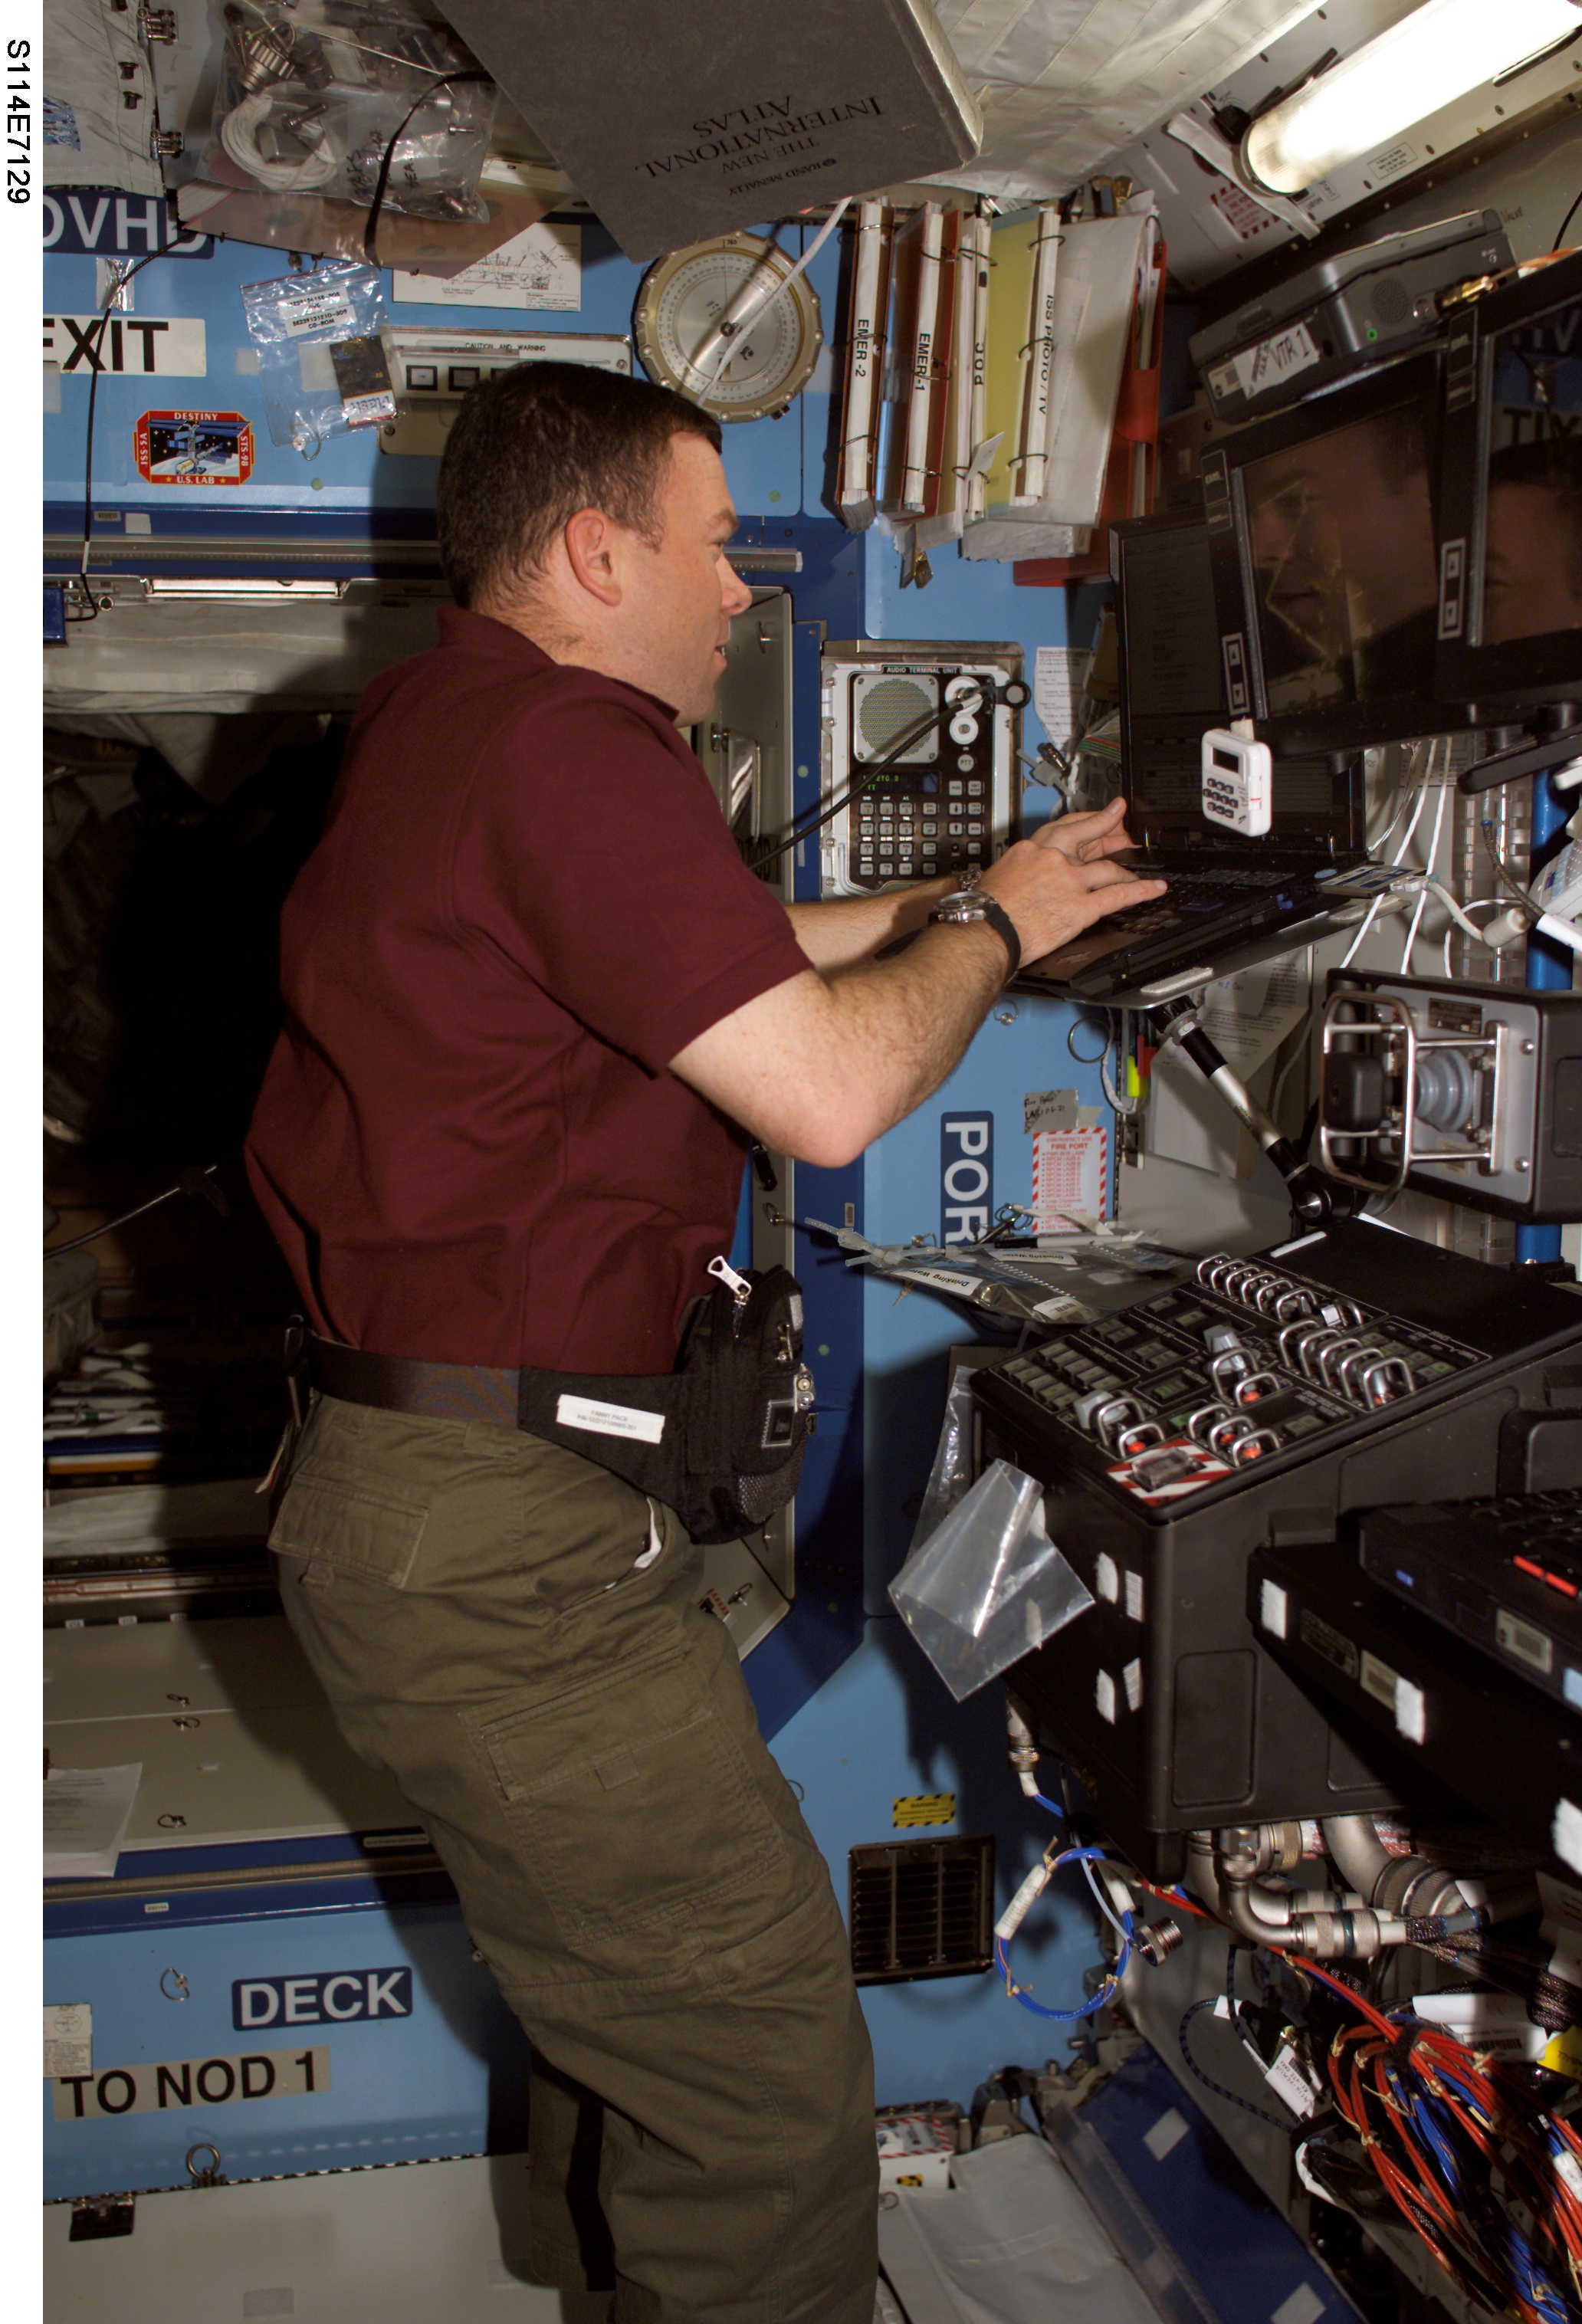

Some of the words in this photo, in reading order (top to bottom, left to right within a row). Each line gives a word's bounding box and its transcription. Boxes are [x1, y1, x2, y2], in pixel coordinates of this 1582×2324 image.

[635, 97, 884, 179] INTERNATIONAL
[691, 95, 794, 140] ATLAS
[721, 148, 770, 175] NEW
[769, 136, 821, 162] THE
[783, 159, 823, 182] RAND
[1045, 294, 1055, 320] ISS
[855, 319, 870, 360] EMER
[916, 333, 931, 376] EMER
[1041, 325, 1054, 382] PHOTO
[174, 412, 218, 421] DESTINY
[176, 476, 192, 484] U.S.
[195, 476, 215, 484] LAB
[944, 1121, 989, 1244] POR
[933, 1273, 970, 1288] Drinking
[241, 1971, 408, 2027] DECK
[61, 2068, 136, 2118] TO
[156, 2055, 276, 2109] NOD
[295, 2050, 316, 2093] 1
